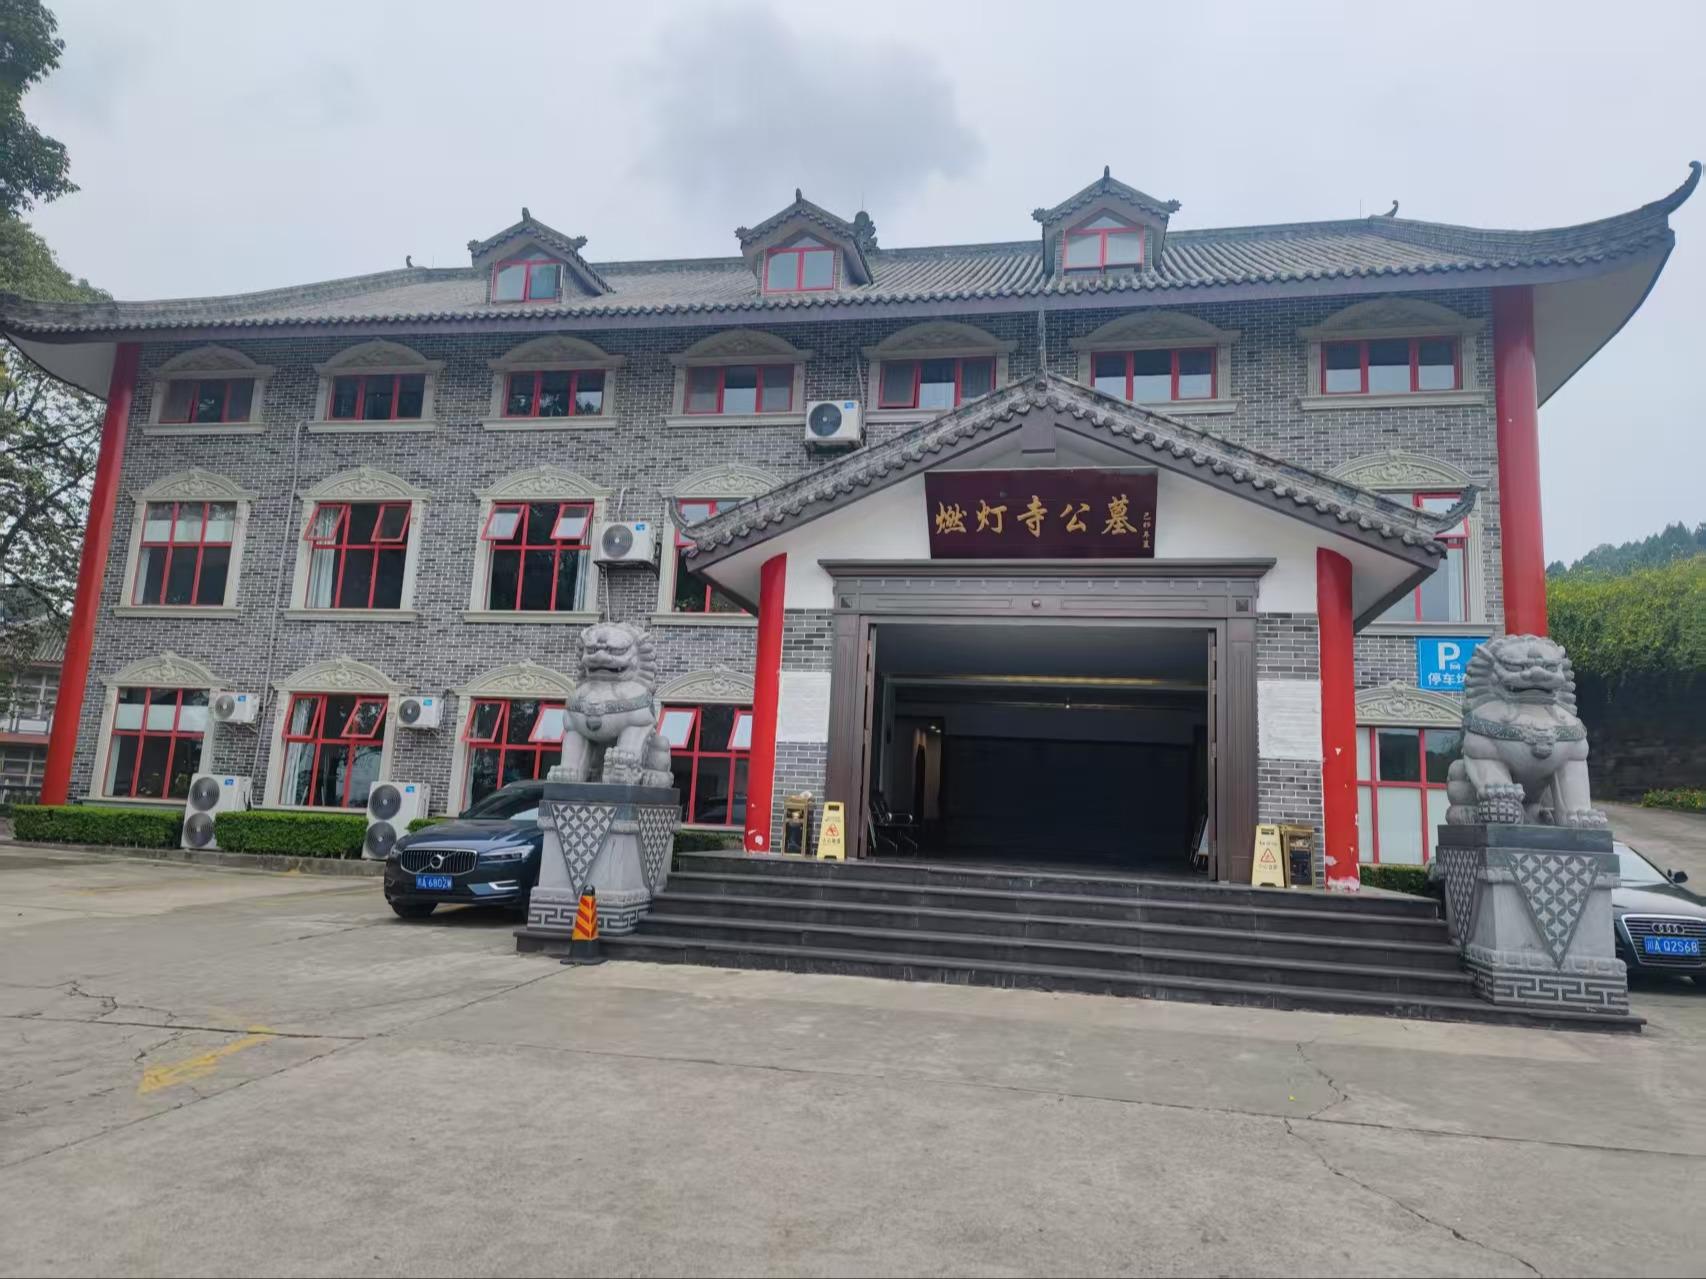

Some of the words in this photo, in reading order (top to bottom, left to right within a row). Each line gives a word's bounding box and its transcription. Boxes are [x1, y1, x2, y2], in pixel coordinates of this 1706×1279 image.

[935, 494, 1137, 538] 燃灯寺公墓
[1437, 642, 1461, 671] P
